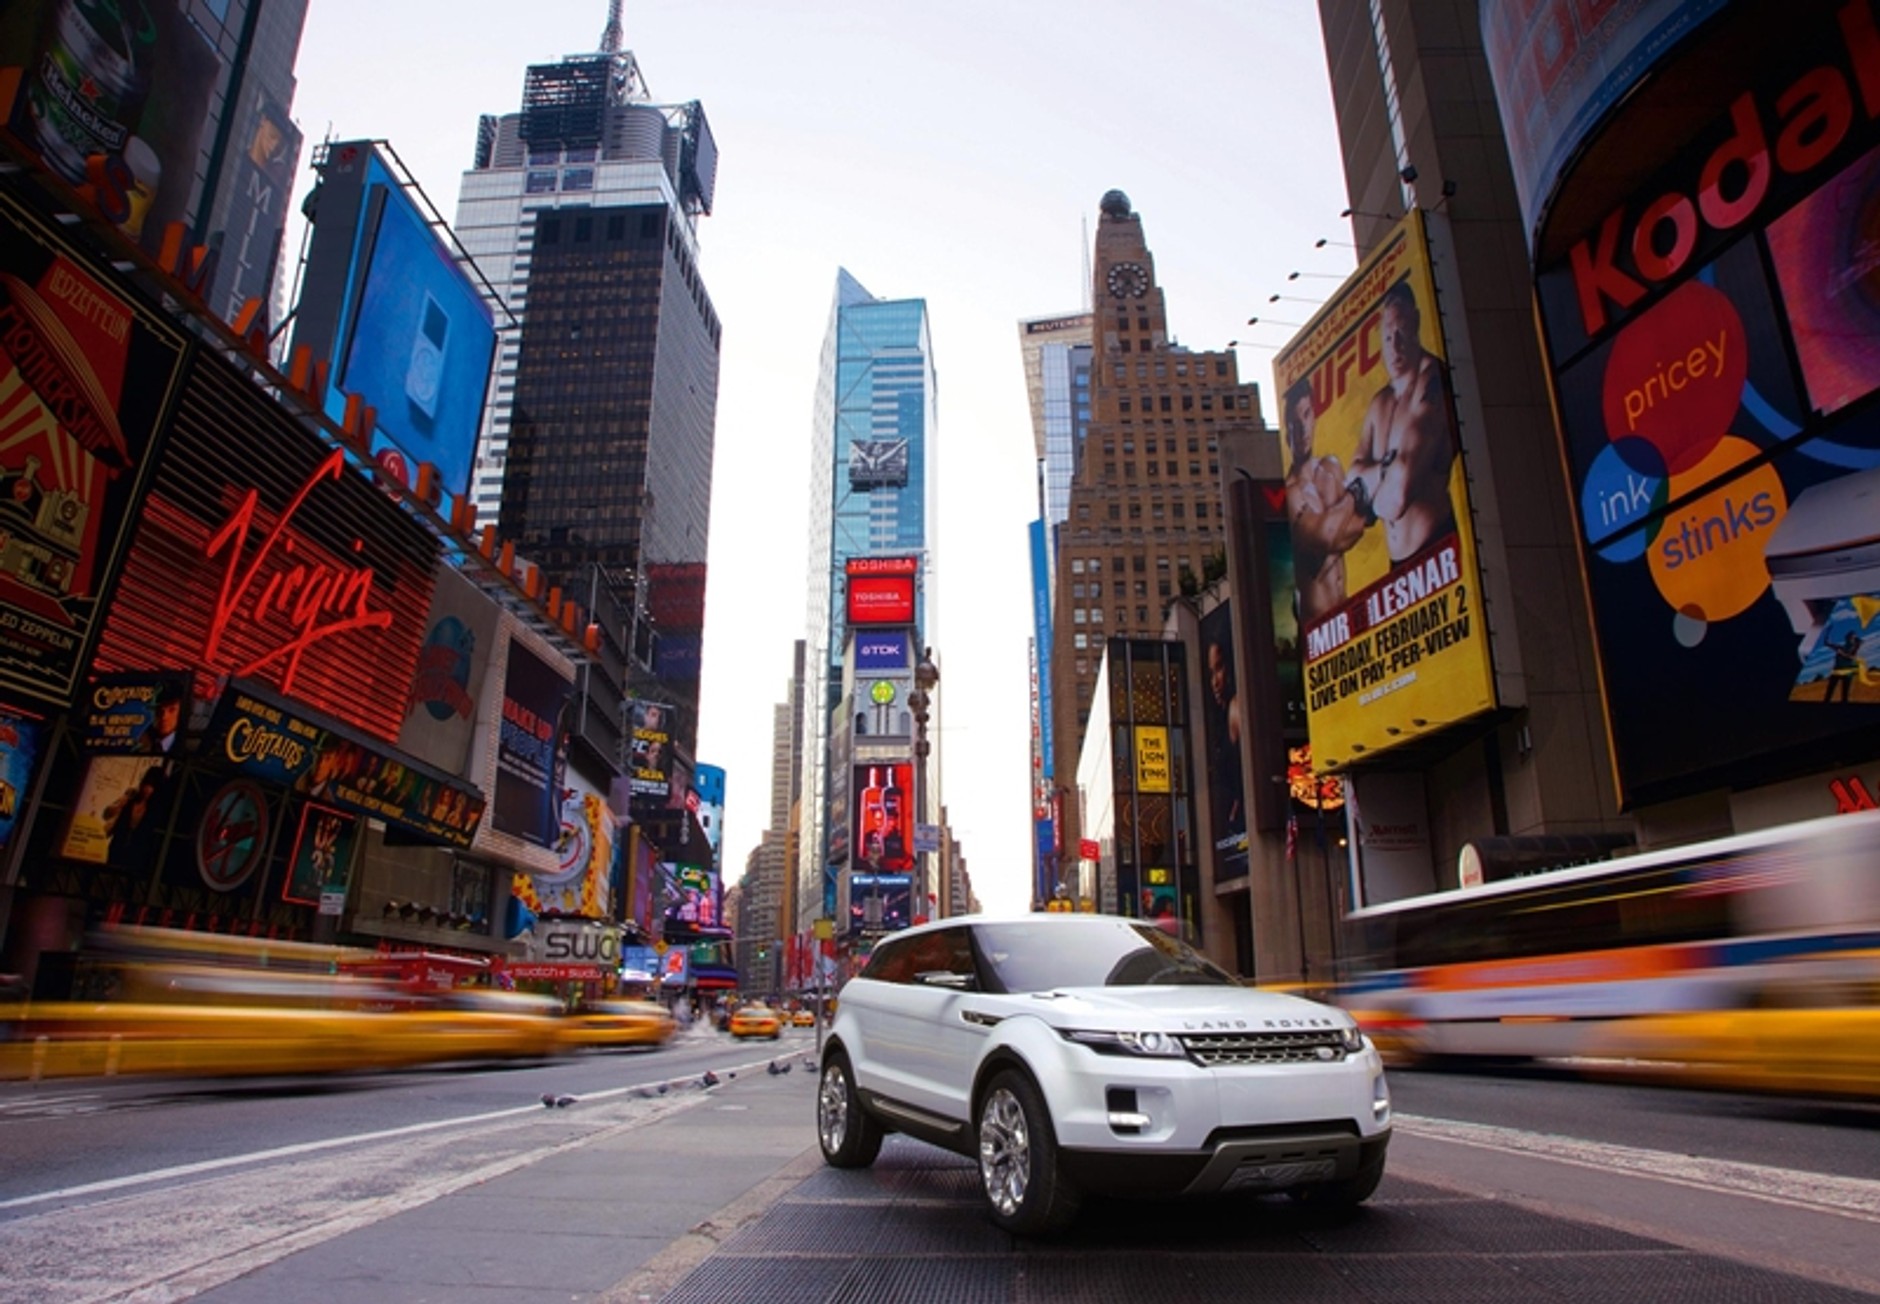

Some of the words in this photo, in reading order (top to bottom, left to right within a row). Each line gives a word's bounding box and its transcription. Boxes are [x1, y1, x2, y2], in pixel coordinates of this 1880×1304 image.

[46, 68, 121, 144] Heineken
[1312, 311, 1382, 418] UFC
[1623, 329, 1727, 432] pricey
[1600, 474, 1652, 527] ink
[1662, 492, 1776, 570] stinks
[203, 447, 392, 695] Virgin
[850, 558, 913, 571] TOSHIBA
[854, 591, 901, 601] TOSHIBA
[1314, 610, 1351, 658] MIR
[1373, 546, 1460, 628] LESNAR
[1375, 593, 1449, 657] FEBRUARY
[1455, 584, 1468, 614] 2
[872, 645, 900, 655] TDK
[1310, 682, 1338, 713] LIVE
[1338, 672, 1360, 699] ON
[1360, 615, 1470, 689] PAY-PER-VIEW
[224, 716, 306, 770] CURTAINS
[1139, 750, 1165, 765] LION
[1142, 738, 1162, 749] THE
[1140, 768, 1167, 783] KING
[514, 966, 558, 979] swatch
[1184, 1020, 1248, 1030] LAND
[1263, 1018, 1334, 1028] ROVER
